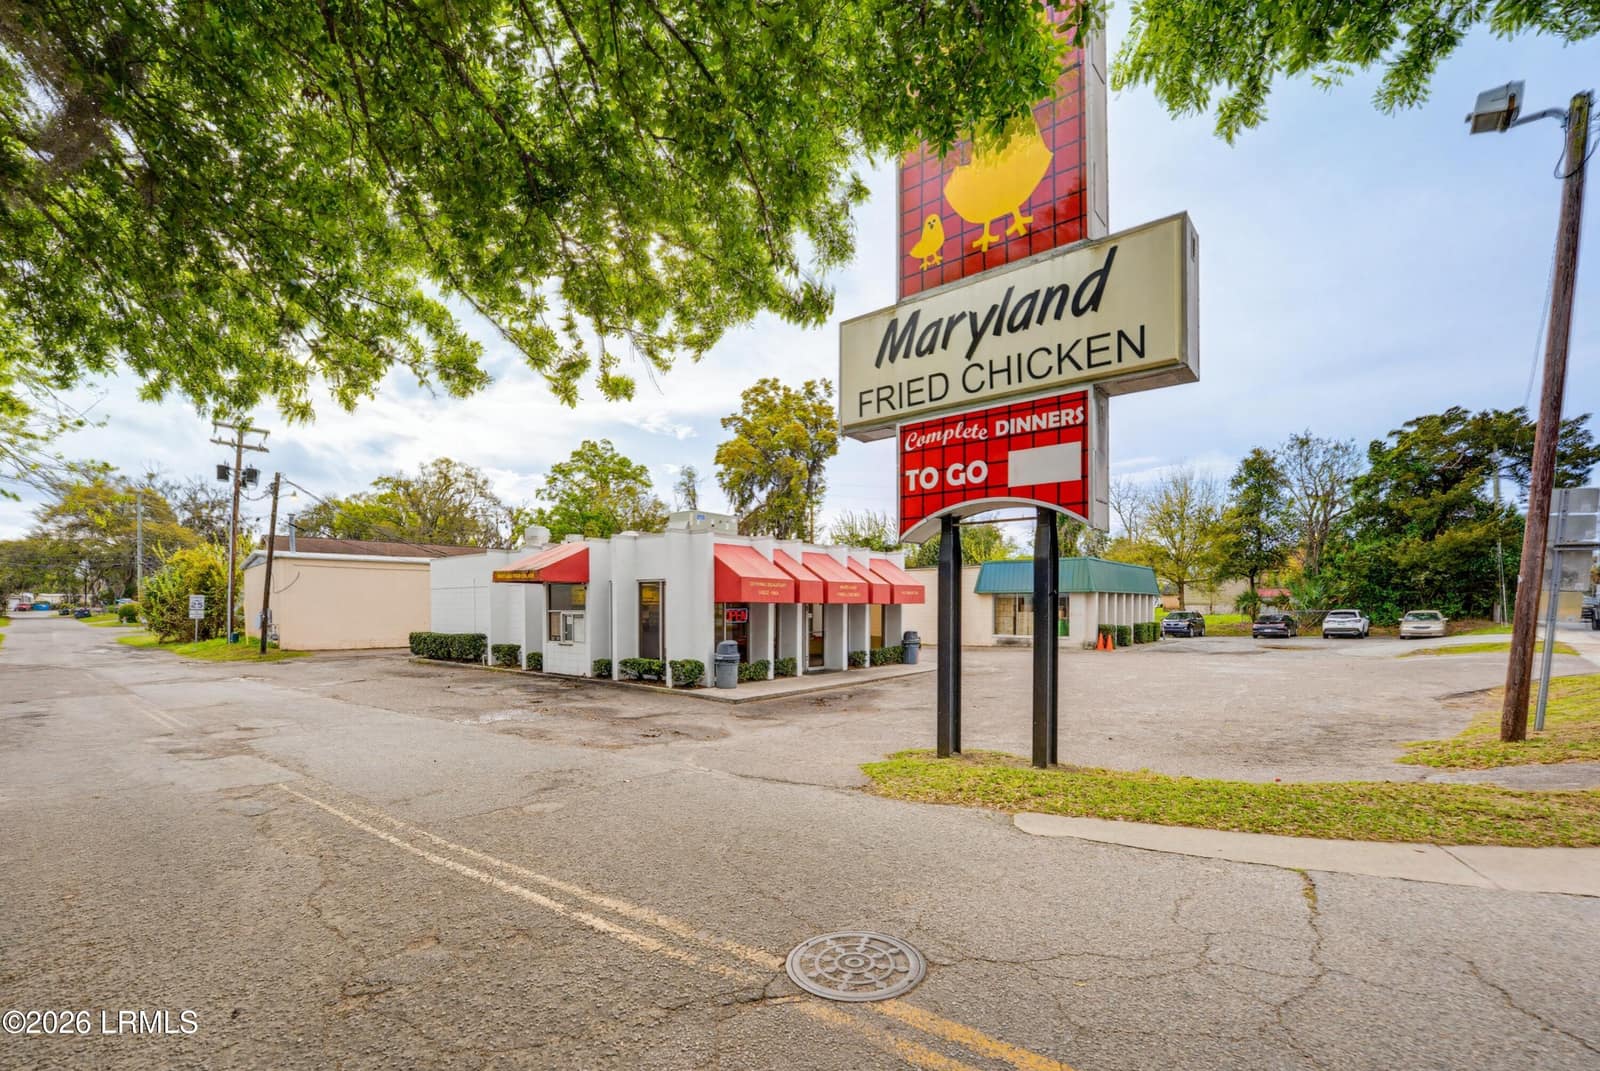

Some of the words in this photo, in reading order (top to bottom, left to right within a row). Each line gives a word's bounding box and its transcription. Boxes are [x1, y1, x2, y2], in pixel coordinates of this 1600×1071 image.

[874, 245, 1118, 369] Maryland
[858, 372, 949, 417] FRIED
[961, 325, 1146, 394] CHICKEN
[904, 420, 989, 452] Complete
[994, 406, 1085, 436] DINNERS
[905, 466, 939, 491] TO
[946, 459, 989, 485] GO
